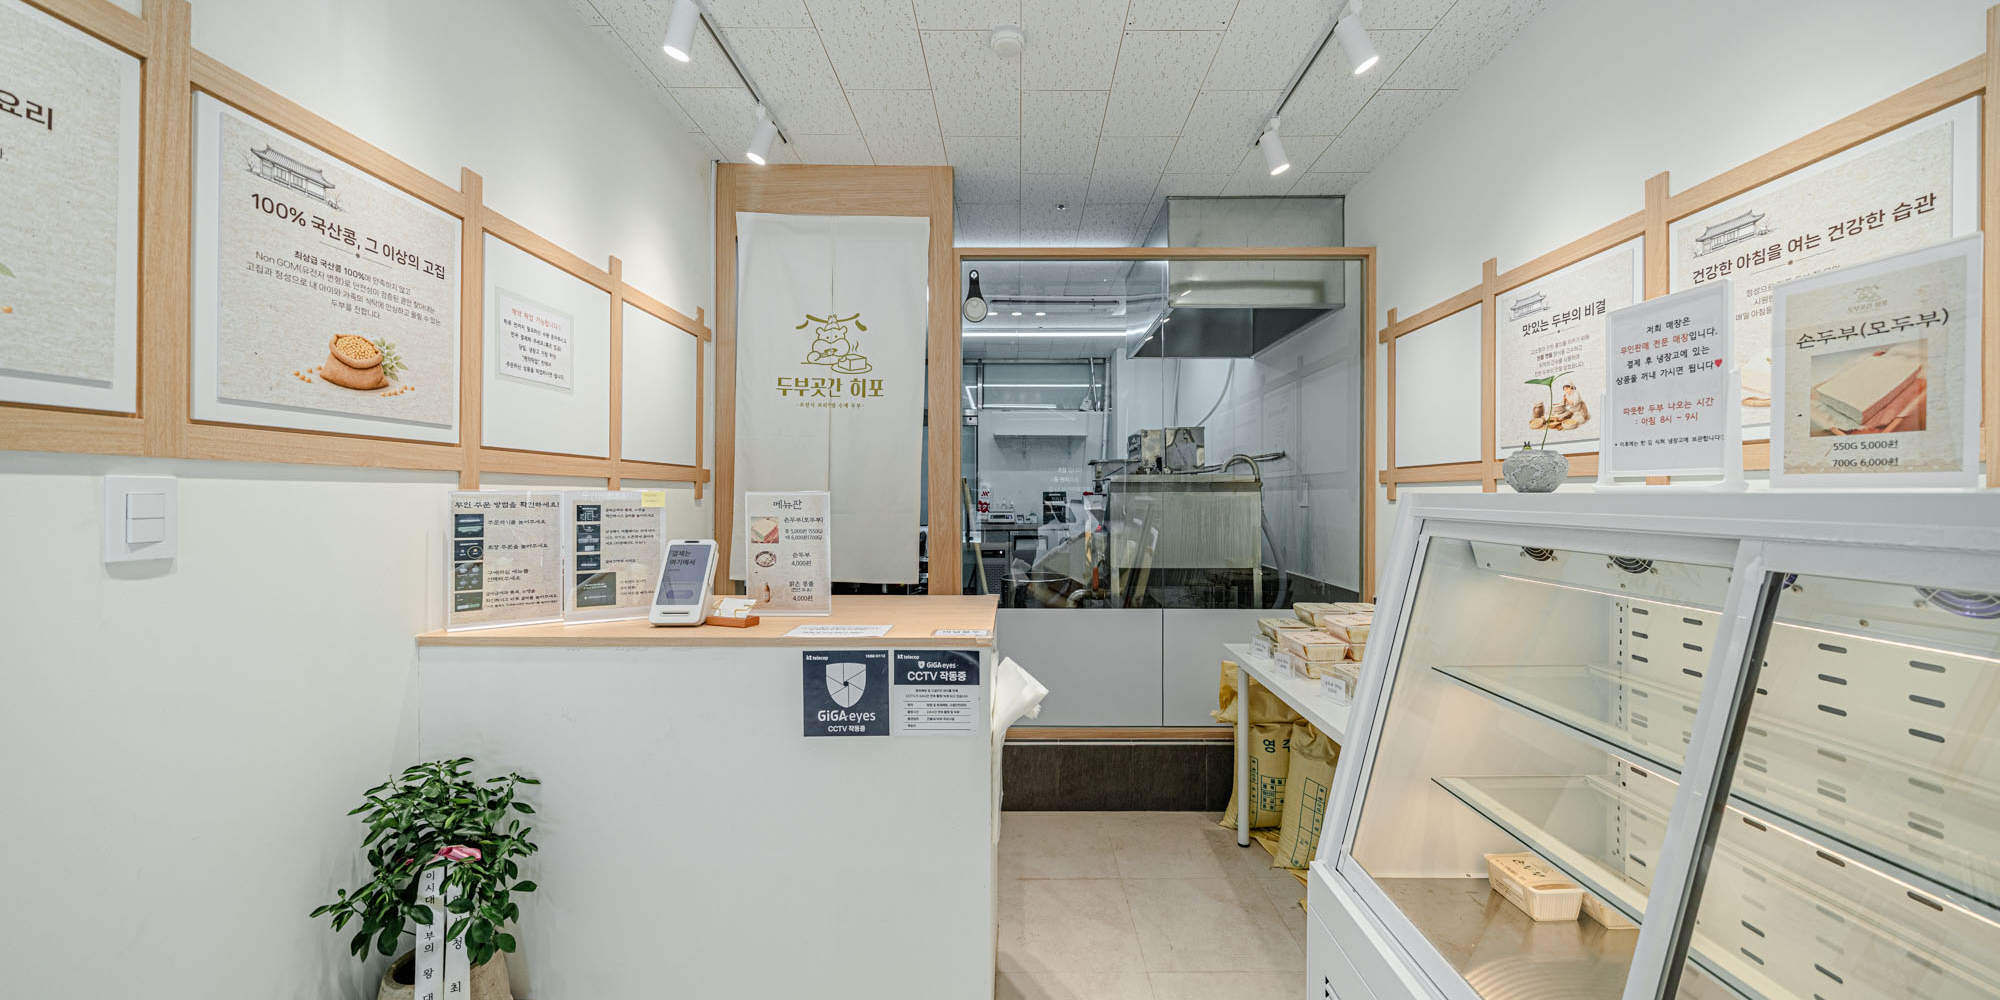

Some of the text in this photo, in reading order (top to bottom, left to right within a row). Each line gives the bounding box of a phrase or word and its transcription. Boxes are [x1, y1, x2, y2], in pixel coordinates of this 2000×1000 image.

[250, 193, 446, 281] 100% 국산콩, 그 이상의 고집
[1692, 191, 1937, 285] 건강한 아침을 여는 건강한 습관
[295, 251, 318, 266] 최상급
[320, 259, 342, 273] 국산콩
[246, 261, 272, 277] 고집과
[275, 270, 308, 287] 정성으로
[319, 284, 341, 297] 아이와
[255, 251, 275, 265] Non
[353, 281, 379, 297] 안전성이
[330, 299, 352, 312] 두부를
[1522, 299, 1606, 338] 맛있는 두부의 비결
[1646, 316, 1691, 334] 저희 매장은
[1796, 307, 1949, 350] 손두부(모두부)
[1620, 326, 1719, 355] 무인판매 전문 매장입니다.
[1626, 344, 1710, 369] 결제 후 냉장고에 있는
[1615, 374, 1638, 386] 상품을
[1641, 370, 1657, 381] 꺼내
[1660, 365, 1684, 378] 가시면
[776, 377, 884, 398] 두부곳간 히포
[1623, 396, 1715, 416] 따뜻한 두부 나오는 시간
[1640, 416, 1656, 426] 아침
[1659, 414, 1673, 424] 8시
[1684, 411, 1699, 422] 9시
[1832, 439, 1899, 451] 550G 5,000원
[1832, 457, 1899, 468] 700G 6,000원
[454, 501, 472, 509] 무인
[493, 501, 517, 509] 방법을
[520, 501, 560, 509] 확인하세요!
[772, 499, 803, 510] 메뉴판
[907, 671, 967, 682] CCTV 작동중
[817, 710, 876, 724] GiGA eyes
[827, 725, 848, 733] CCTV
